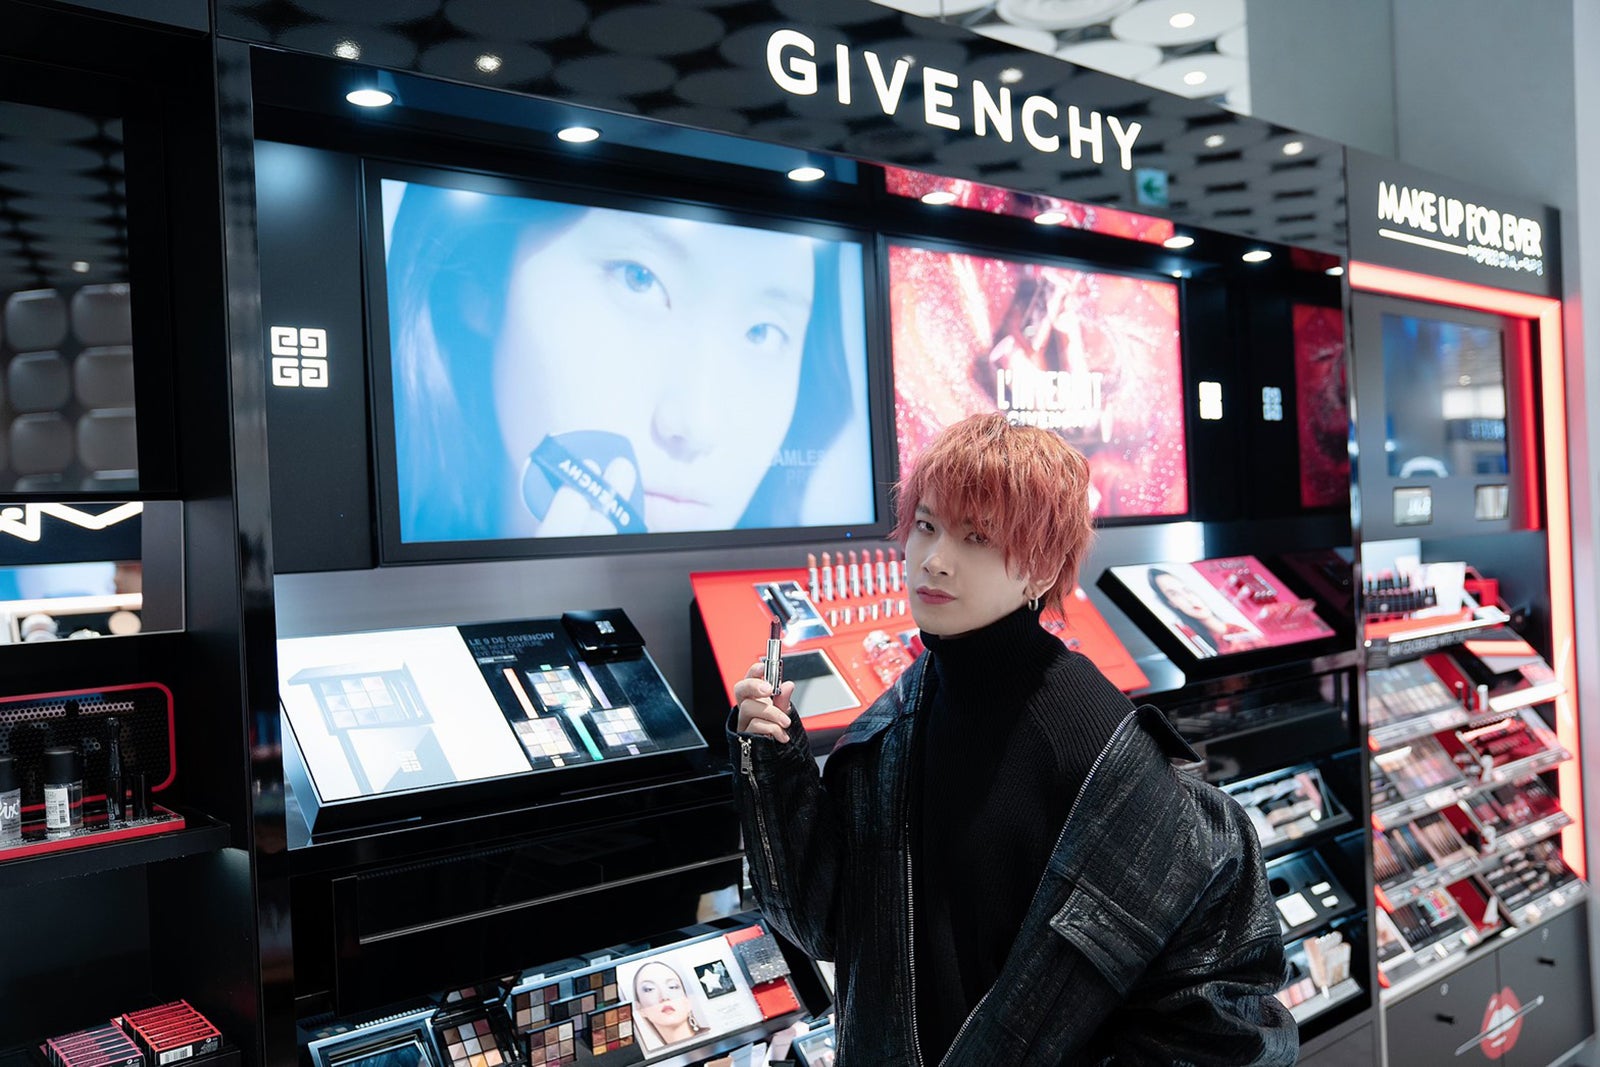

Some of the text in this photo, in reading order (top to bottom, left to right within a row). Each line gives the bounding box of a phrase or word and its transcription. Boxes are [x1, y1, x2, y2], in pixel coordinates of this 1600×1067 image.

[766, 29, 1142, 171] GIVENCHY
[1378, 180, 1543, 258] MAKE UP FOR EVER
[558, 459, 630, 527] GIVENCHY
[468, 638, 482, 646] LE
[491, 636, 505, 644] DE
[506, 632, 555, 643] GIVENCHY
